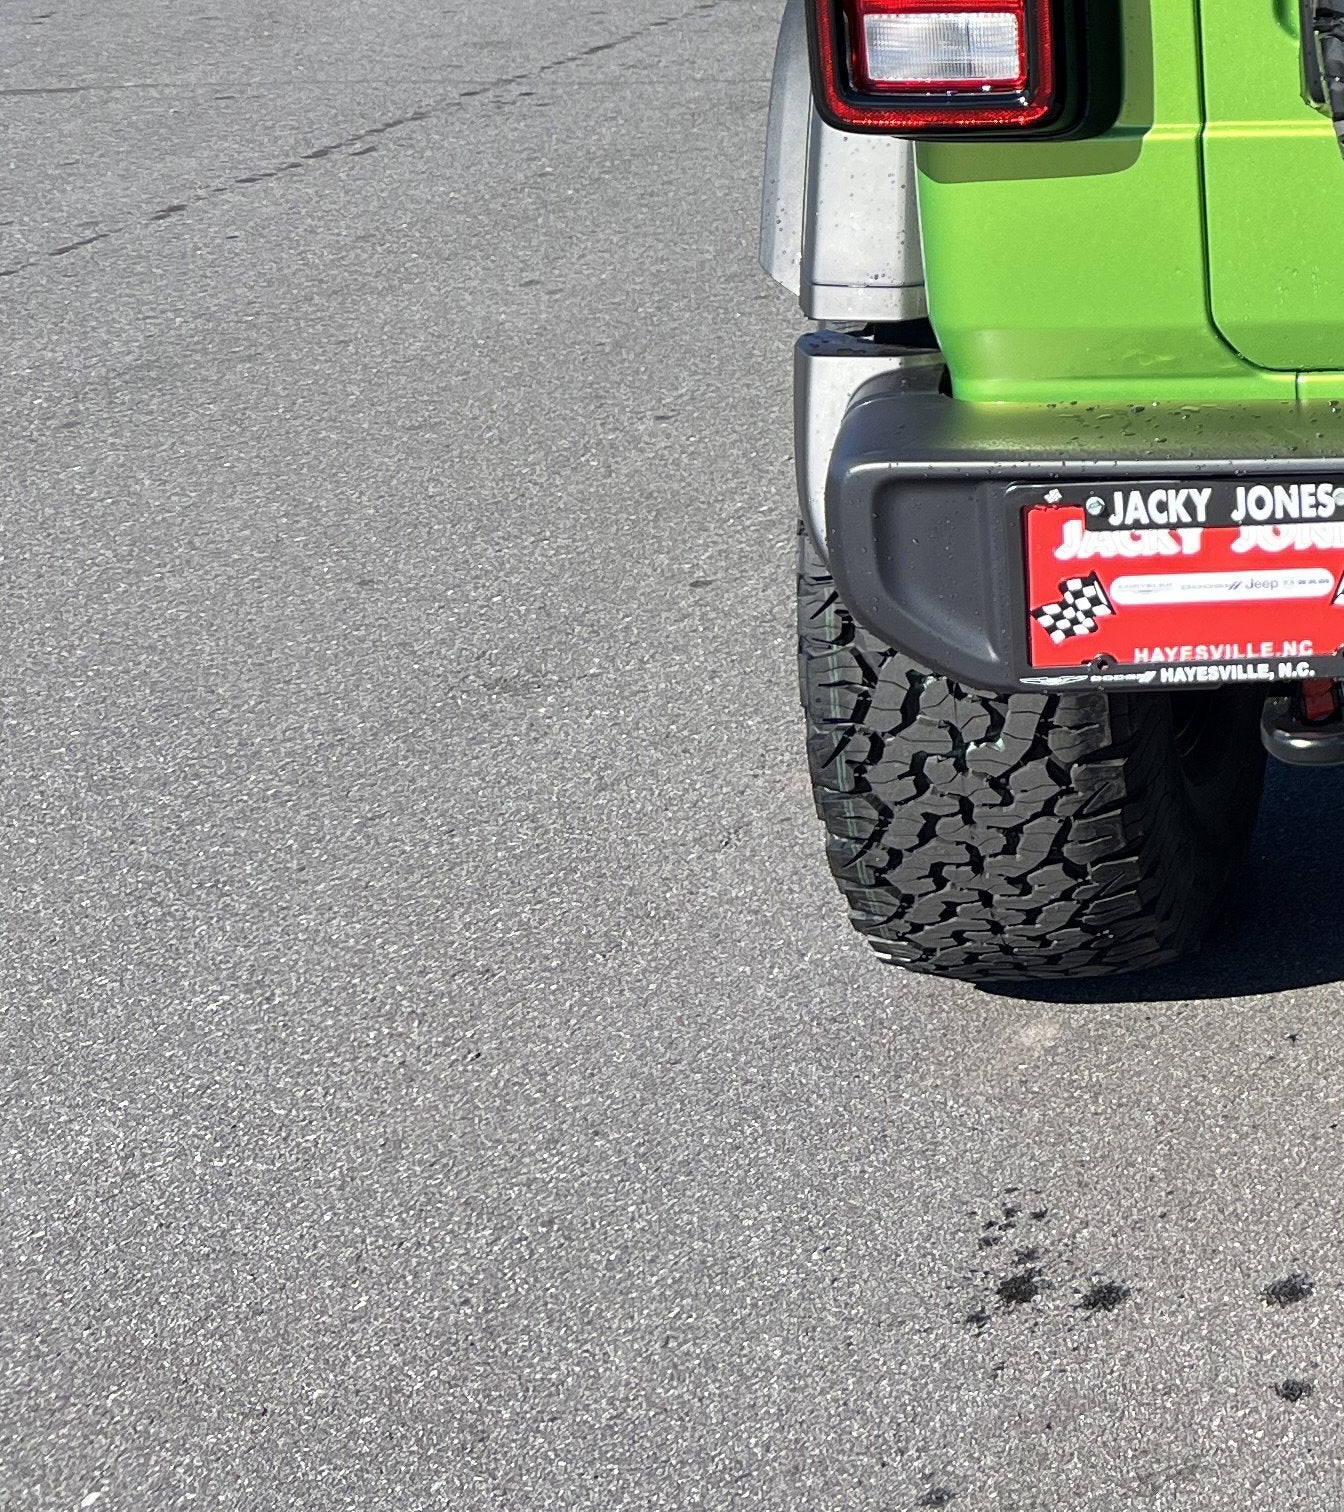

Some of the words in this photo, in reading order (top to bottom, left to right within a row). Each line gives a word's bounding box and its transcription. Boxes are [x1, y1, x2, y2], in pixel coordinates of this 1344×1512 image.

[1108, 487, 1212, 527] JACKY
[1230, 482, 1336, 521] JONES
[1244, 577, 1279, 591] Jeep
[1159, 663, 1275, 684] HAYESVILLE,
[1277, 661, 1316, 679] N.C.
